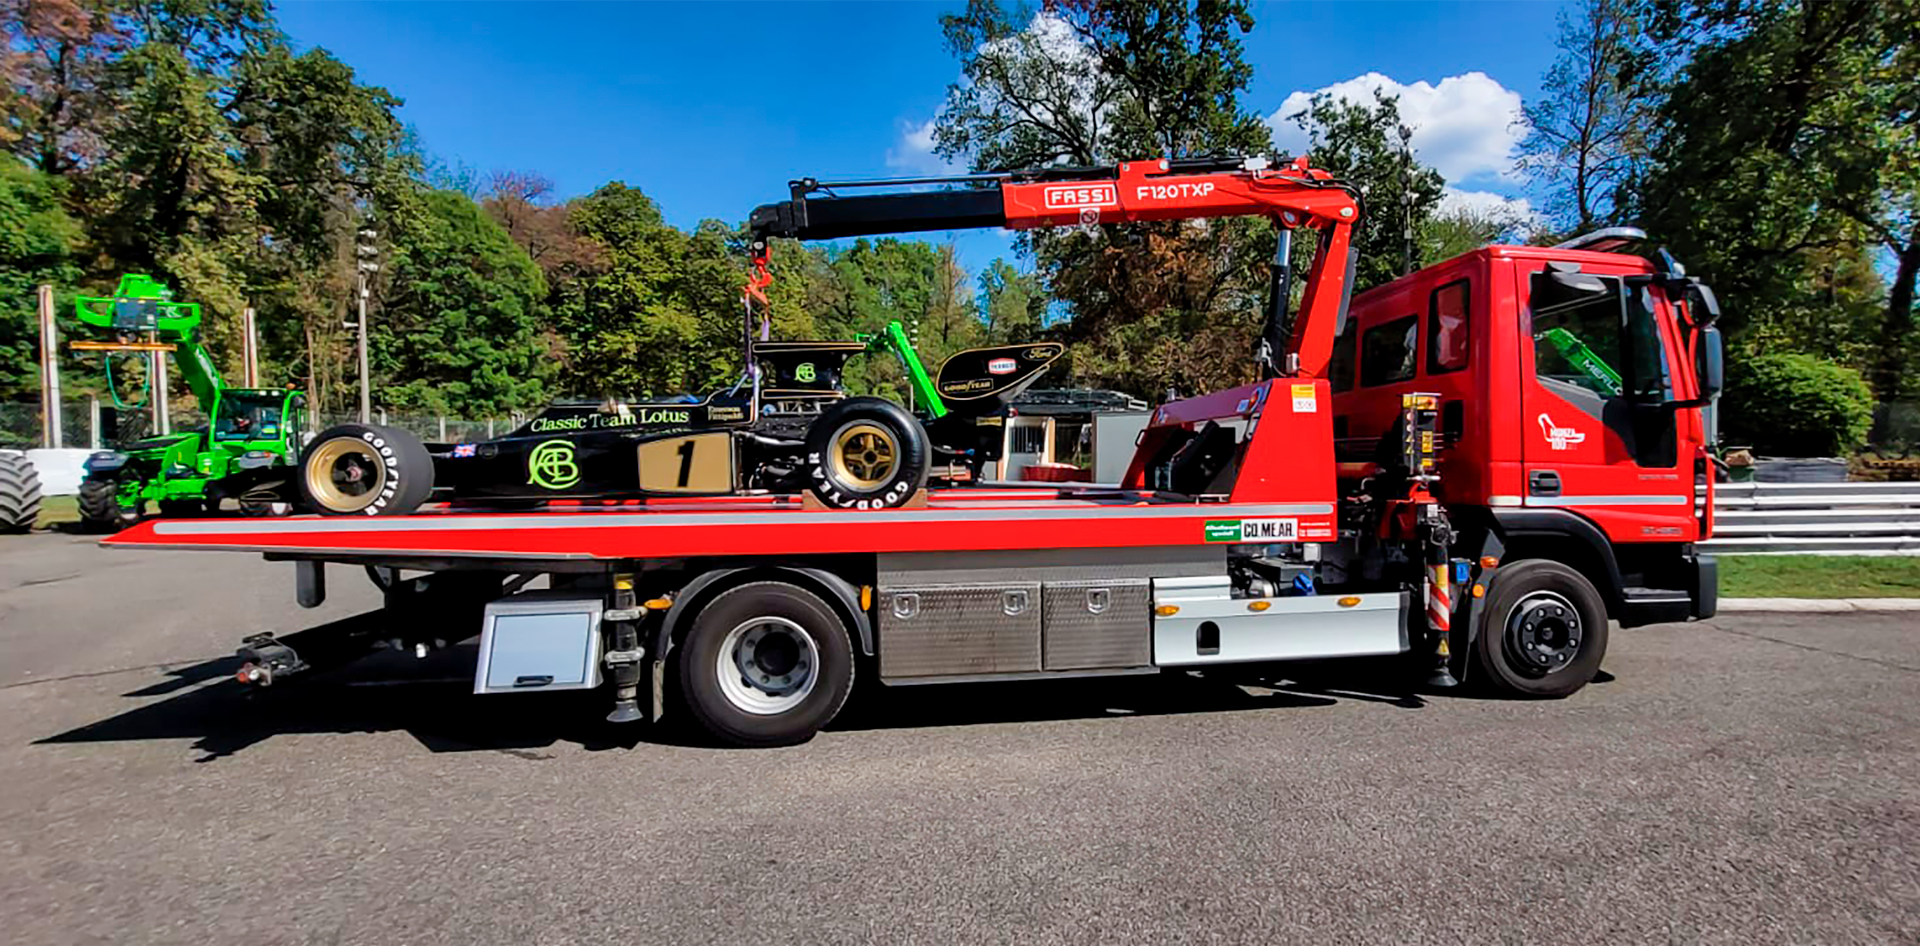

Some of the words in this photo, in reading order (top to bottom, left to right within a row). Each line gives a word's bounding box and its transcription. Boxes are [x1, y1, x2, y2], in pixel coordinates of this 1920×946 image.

[1052, 189, 1110, 204] FASSI
[1137, 183, 1215, 201] F120TXP
[530, 414, 587, 432] Classic
[588, 410, 636, 428] Team
[640, 408, 689, 424] Lotus
[363, 431, 400, 516] GOODYEAR
[676, 440, 696, 487] 1
[808, 452, 909, 511] GOODYEAR
